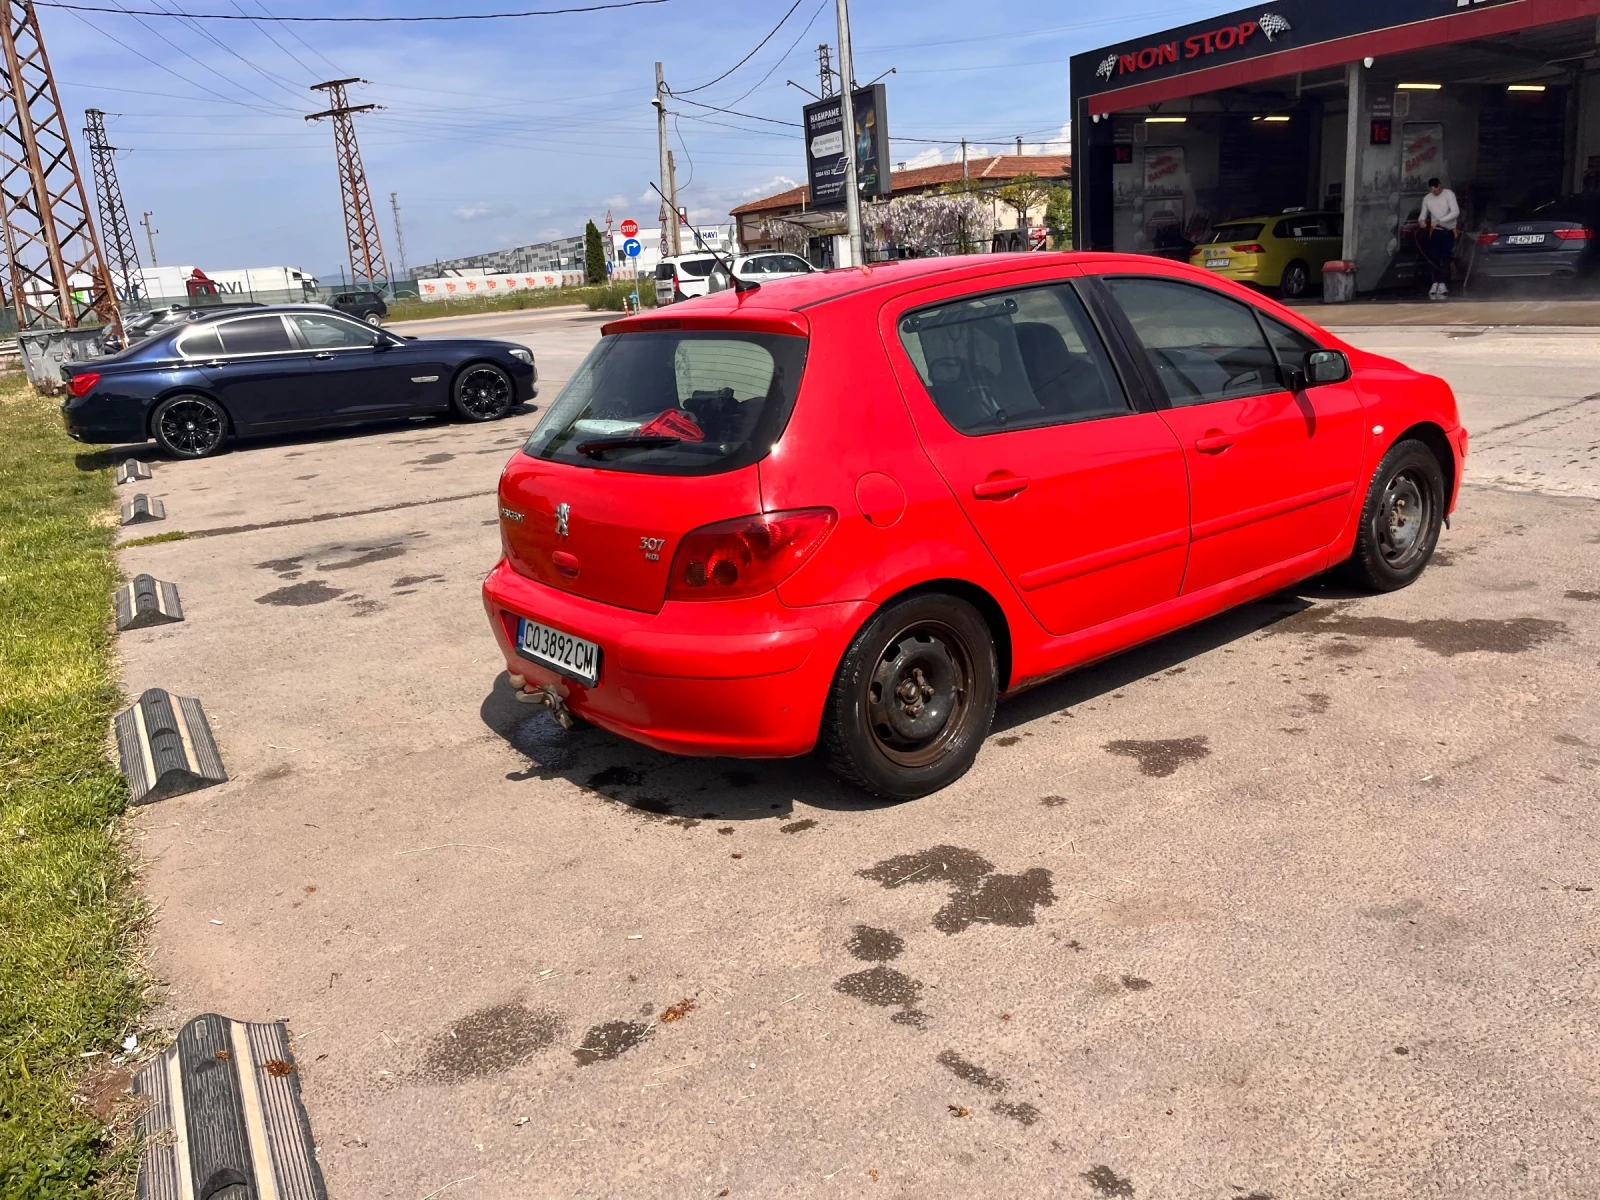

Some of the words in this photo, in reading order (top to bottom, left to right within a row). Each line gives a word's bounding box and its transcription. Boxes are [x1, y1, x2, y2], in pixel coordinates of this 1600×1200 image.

[1119, 42, 1178, 75] NON
[1184, 21, 1256, 58] STOP
[810, 107, 840, 123] НАБИРАМЕ
[621, 224, 637, 233] STOP
[702, 231, 718, 239] HAVI
[218, 281, 243, 295] AVI
[638, 536, 666, 552] 307
[541, 629, 574, 666] 3892
[574, 642, 594, 675] CM
